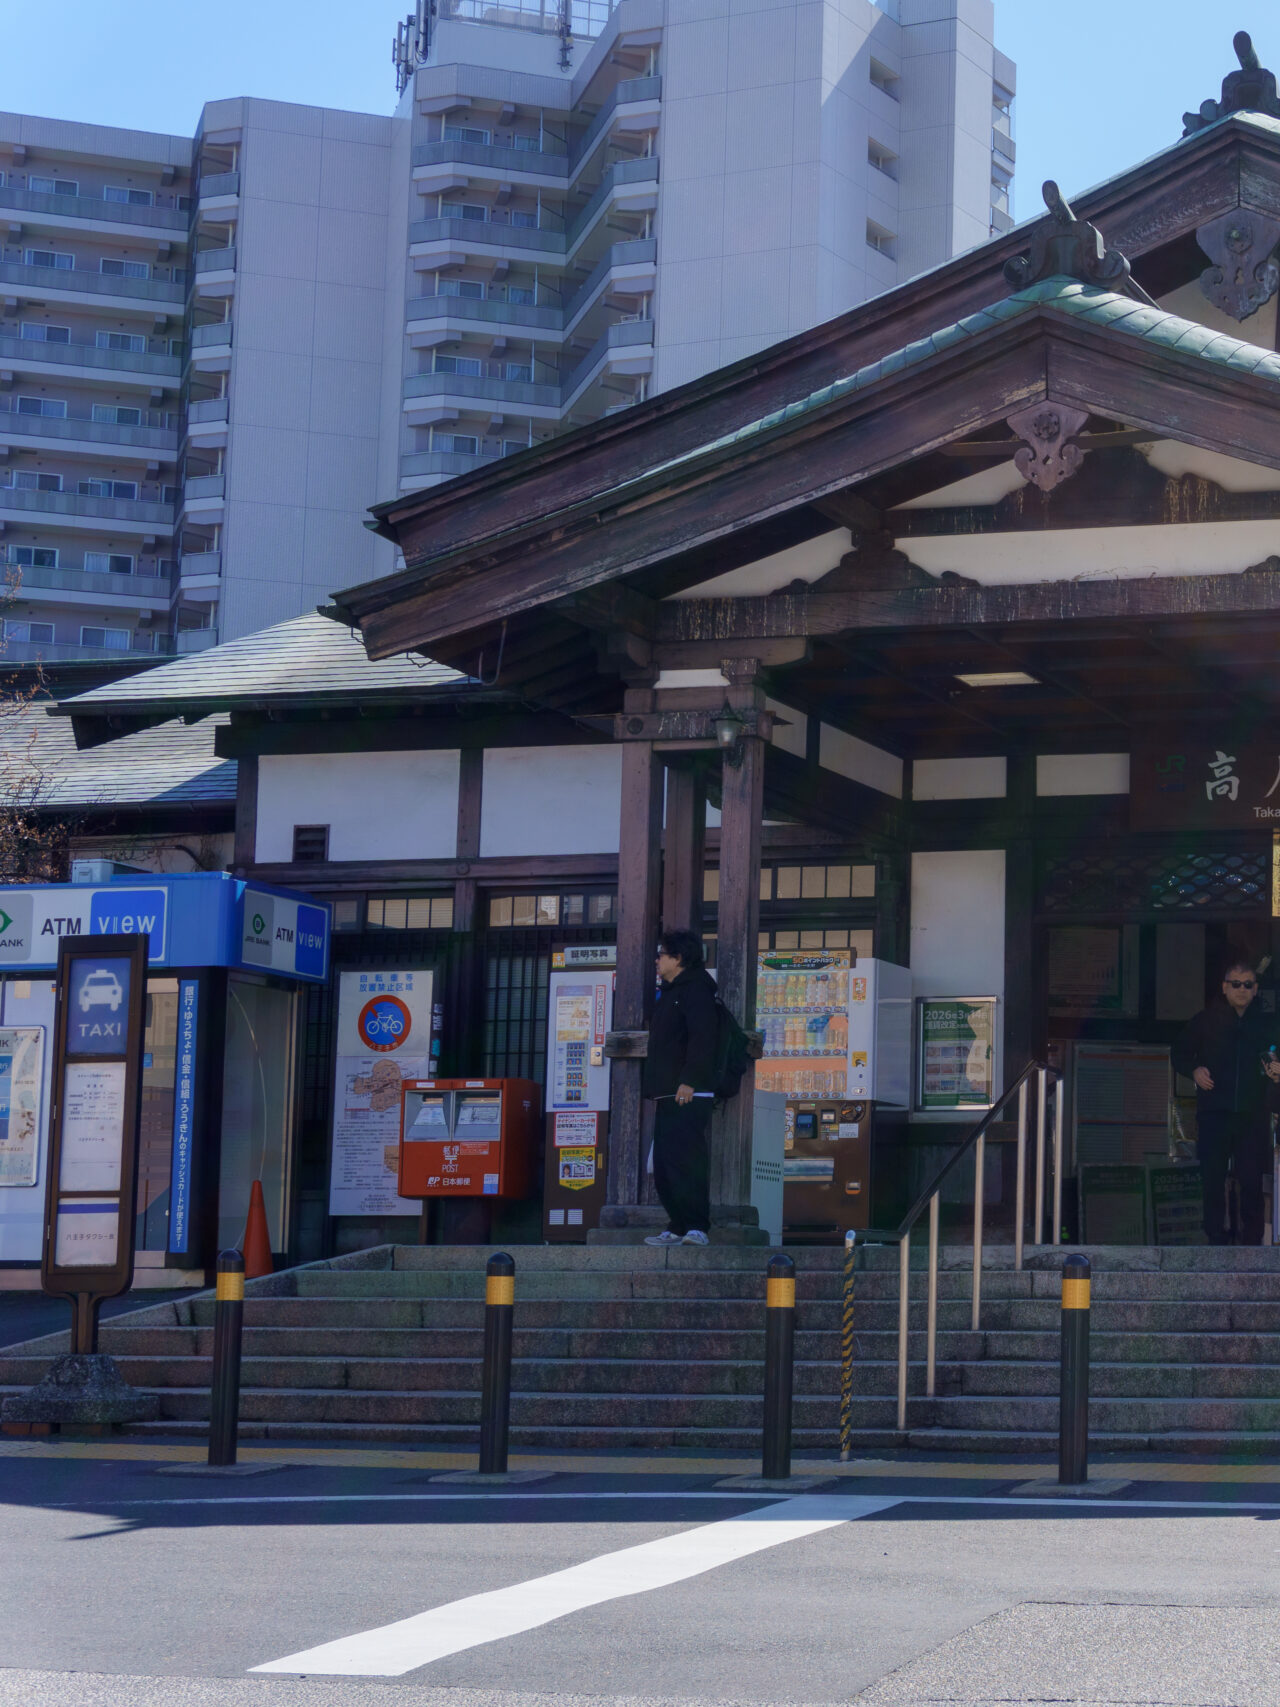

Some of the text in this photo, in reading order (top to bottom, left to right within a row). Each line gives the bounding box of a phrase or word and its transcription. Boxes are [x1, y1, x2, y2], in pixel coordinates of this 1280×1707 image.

[1155, 754, 1187, 773] JR
[41, 917, 82, 936] ATM
[275, 927, 294, 943] ATM
[571, 949, 608, 959] 証明写真
[360, 973, 414, 982] 自転車等
[359, 982, 414, 992] 放置禁止区域
[78, 1022, 121, 1037] TAXI
[442, 1145, 460, 1156] 郵便
[441, 1164, 459, 1173] POST
[442, 1178, 471, 1186] 日本郵便
